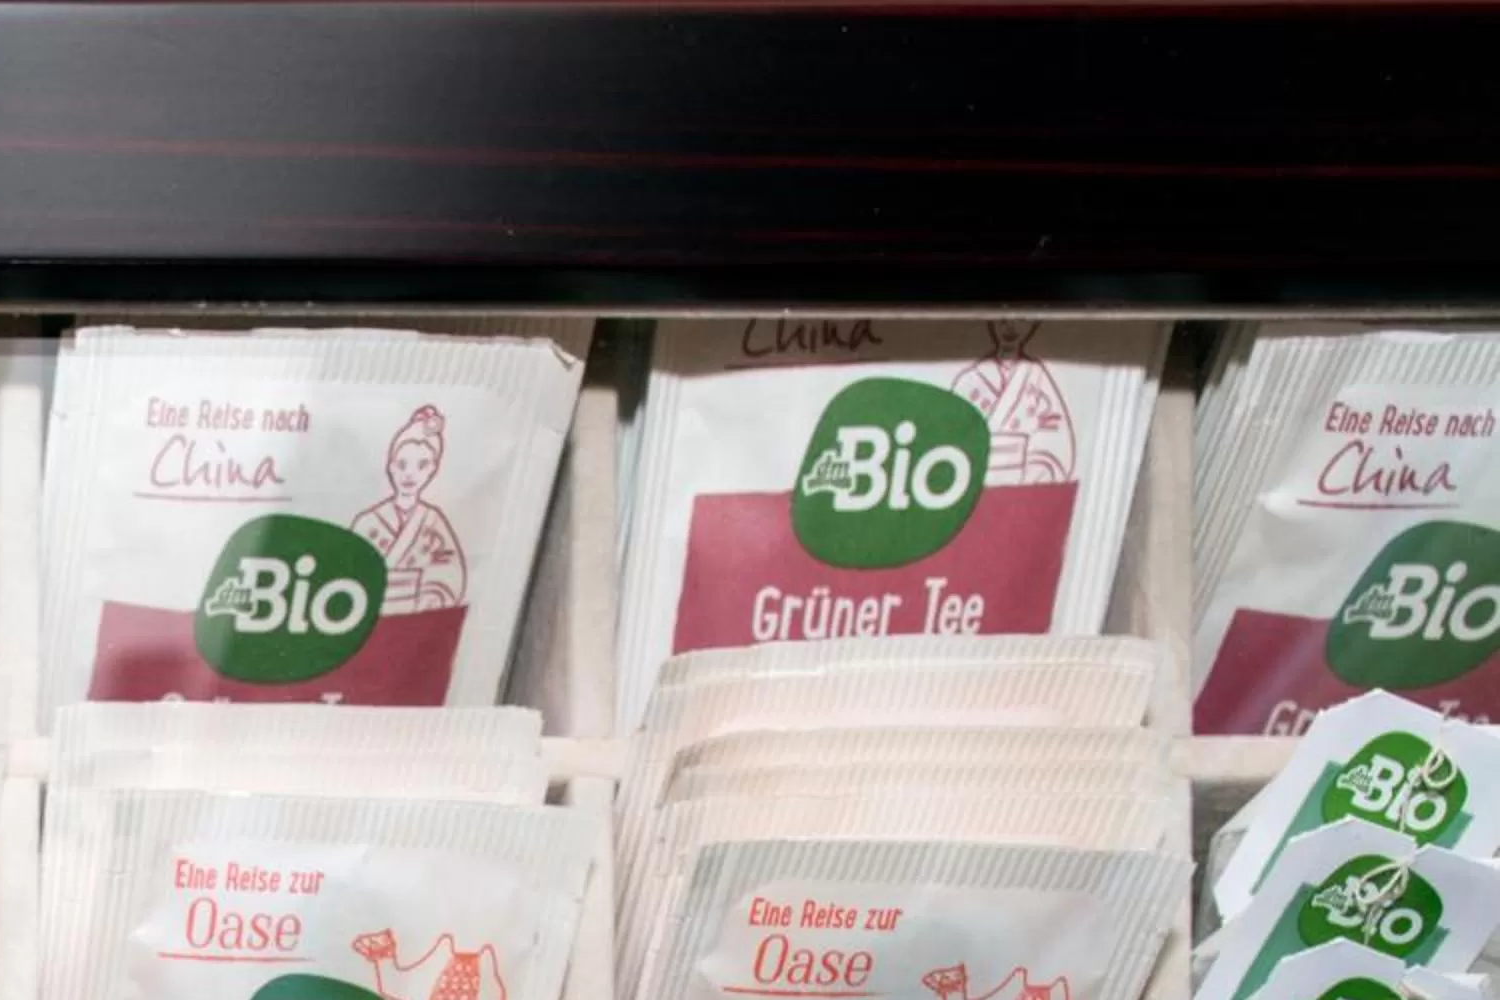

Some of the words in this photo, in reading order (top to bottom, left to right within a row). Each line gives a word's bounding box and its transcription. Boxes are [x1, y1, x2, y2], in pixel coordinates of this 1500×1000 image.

[148, 396, 189, 428] Eine
[197, 400, 254, 430] Reise
[261, 403, 310, 432] nach
[1324, 402, 1370, 434] Eine
[1379, 405, 1438, 436] Reise
[1444, 408, 1496, 438] nach
[151, 433, 285, 489] China
[834, 421, 970, 512] Bio
[1317, 439, 1457, 496] China
[235, 555, 367, 634] Bio
[753, 586, 902, 640] Grüner
[924, 577, 984, 635] Tee
[1368, 560, 1500, 641] Bio
[174, 858, 216, 891] Eine
[225, 861, 282, 893] Reise
[288, 868, 325, 895] zur
[185, 897, 302, 951] Oase
[749, 897, 792, 928] Eine
[800, 899, 857, 930] Reise
[864, 905, 903, 932] zur
[752, 933, 874, 986] Oase
